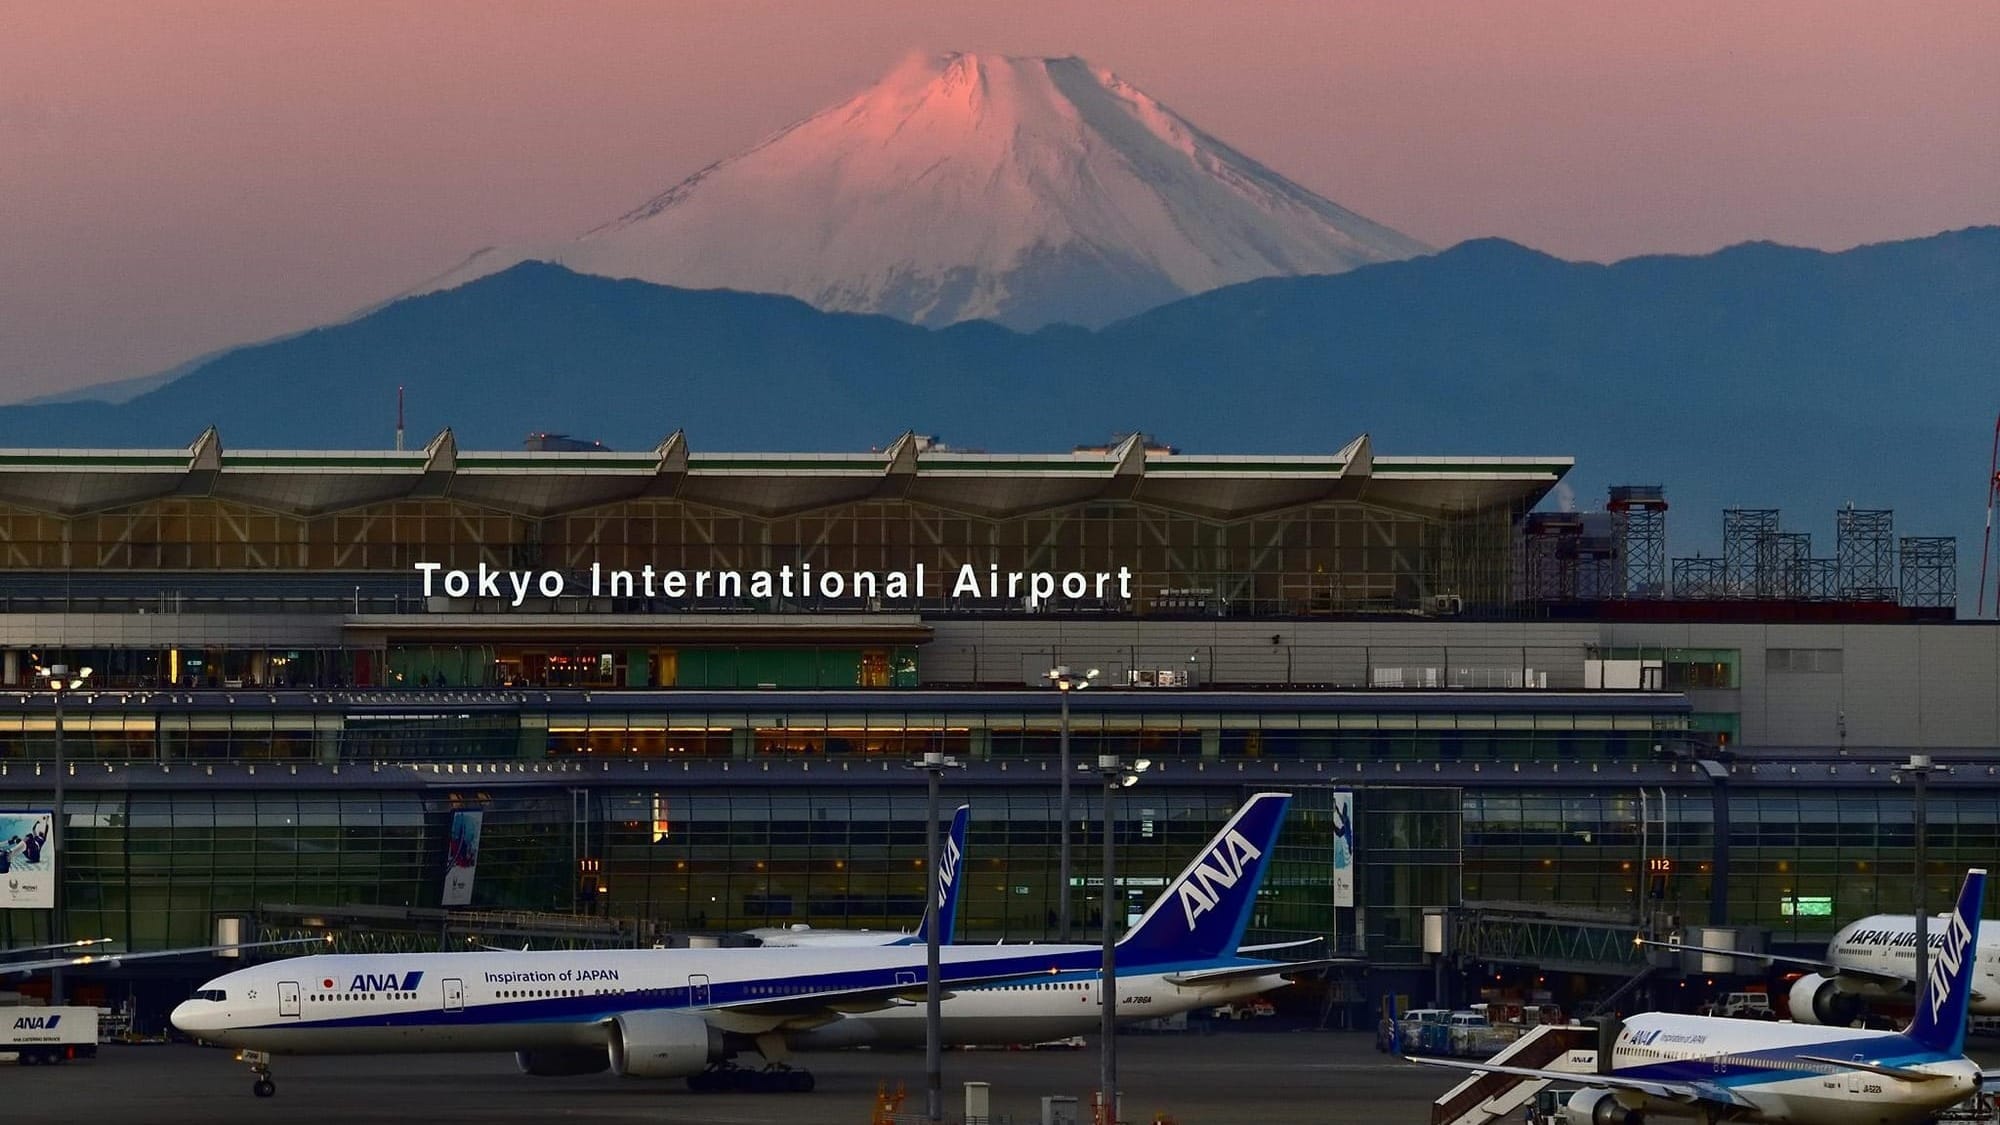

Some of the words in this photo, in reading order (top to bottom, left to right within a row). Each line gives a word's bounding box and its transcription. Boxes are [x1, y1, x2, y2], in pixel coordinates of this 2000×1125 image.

[414, 561, 564, 607] Tokyo
[590, 562, 925, 598] International
[952, 562, 1133, 607] Airport
[581, 860, 599, 871] 111
[1651, 859, 1670, 870] 112
[1178, 828, 1262, 932] ANA
[1846, 928, 1894, 946] JAPAN
[1930, 907, 1962, 1026] ANA
[349, 973, 400, 992] ANA
[484, 970, 556, 984] Inspiration
[559, 970, 572, 982] of
[576, 969, 619, 982] JAPAN
[13, 1017, 44, 1030] ANA
[1629, 1029, 1651, 1045] ANA
